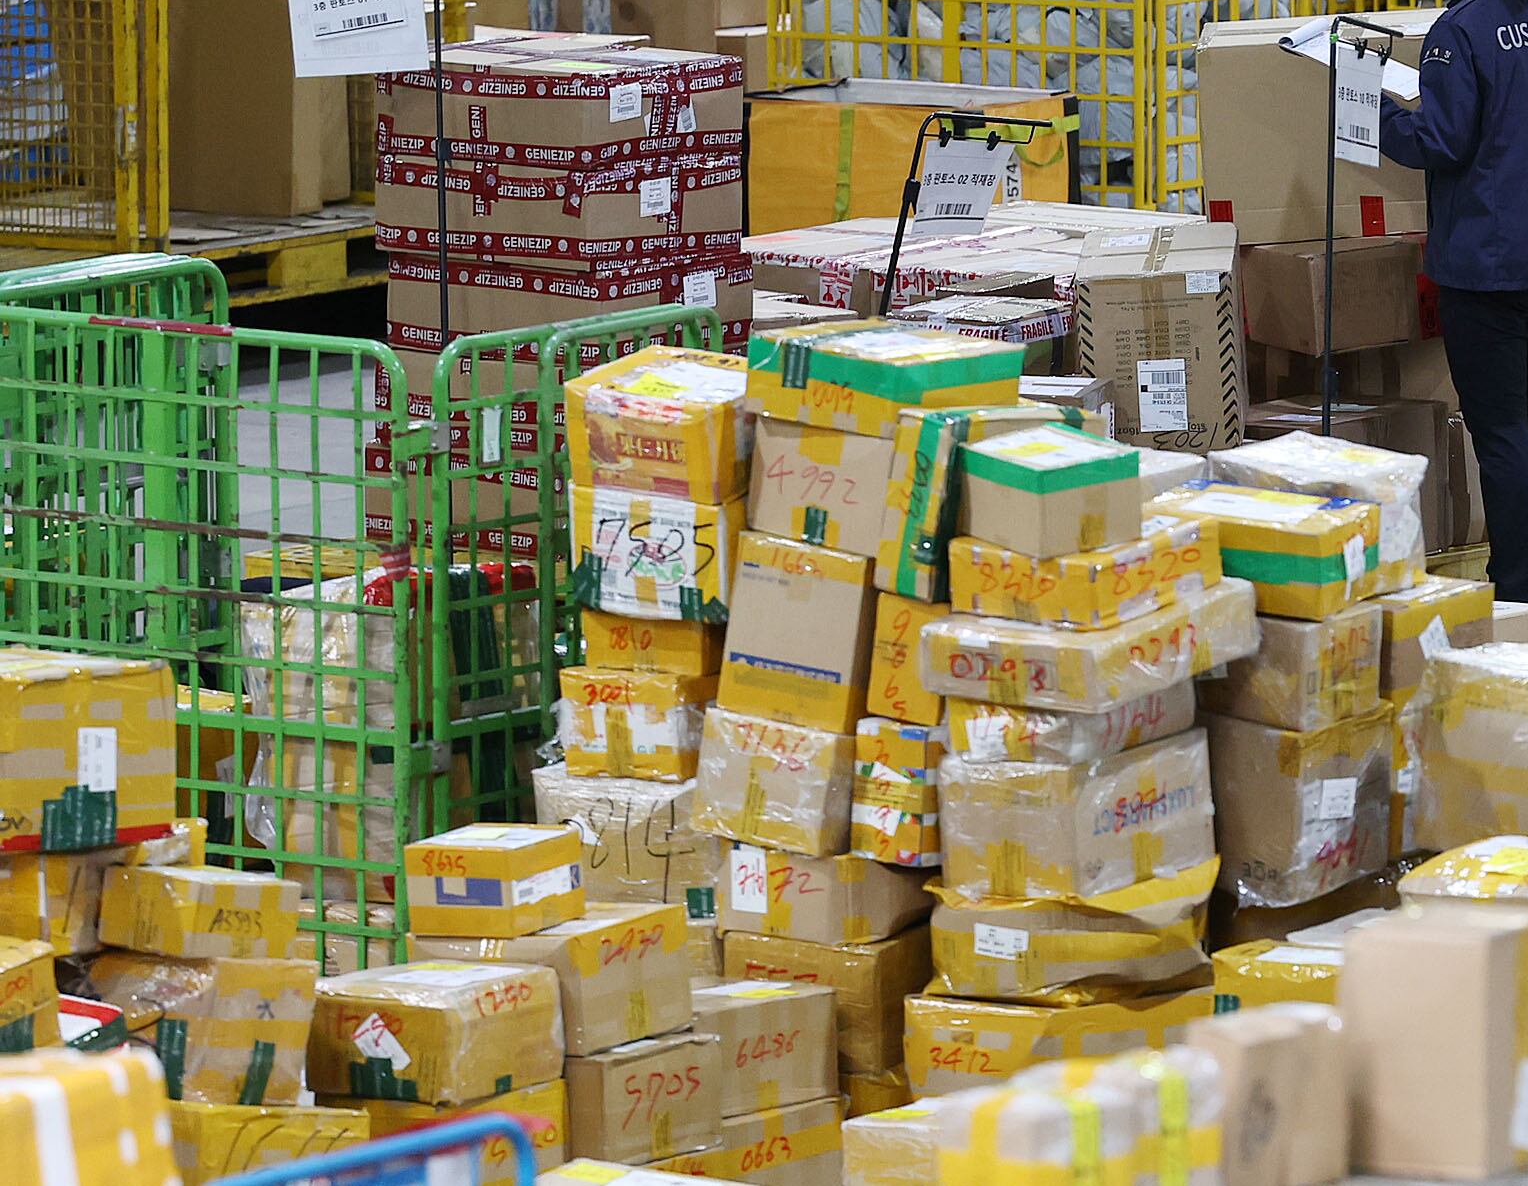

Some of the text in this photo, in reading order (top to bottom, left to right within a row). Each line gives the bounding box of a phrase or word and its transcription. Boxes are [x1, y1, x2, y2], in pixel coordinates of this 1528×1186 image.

[313, 2, 327, 12] 3층
[478, 82, 526, 96] GENIEZIP
[552, 83, 606, 97] GENIEZIP
[639, 136, 681, 151] GENIEZIP
[702, 132, 743, 145] GENIEZIP
[450, 141, 500, 156] GENIEZIP
[525, 147, 575, 162] GENIEZIP
[701, 168, 741, 187] GENIEZIP
[933, 173, 955, 186] 판토스
[958, 175, 968, 185] 02
[970, 174, 996, 187] 적재장
[498, 184, 545, 198] GENIEZIP
[503, 236, 552, 250] GENIEZIP
[578, 241, 621, 254] GENIEZIP
[475, 273, 523, 289] GENIEZIP
[622, 277, 662, 296] GENIEZIP
[549, 282, 599, 298] GENIEZIP
[1021, 318, 1054, 341] FRAGILE
[766, 455, 860, 505] 4992
[929, 1046, 1000, 1075] 3412
